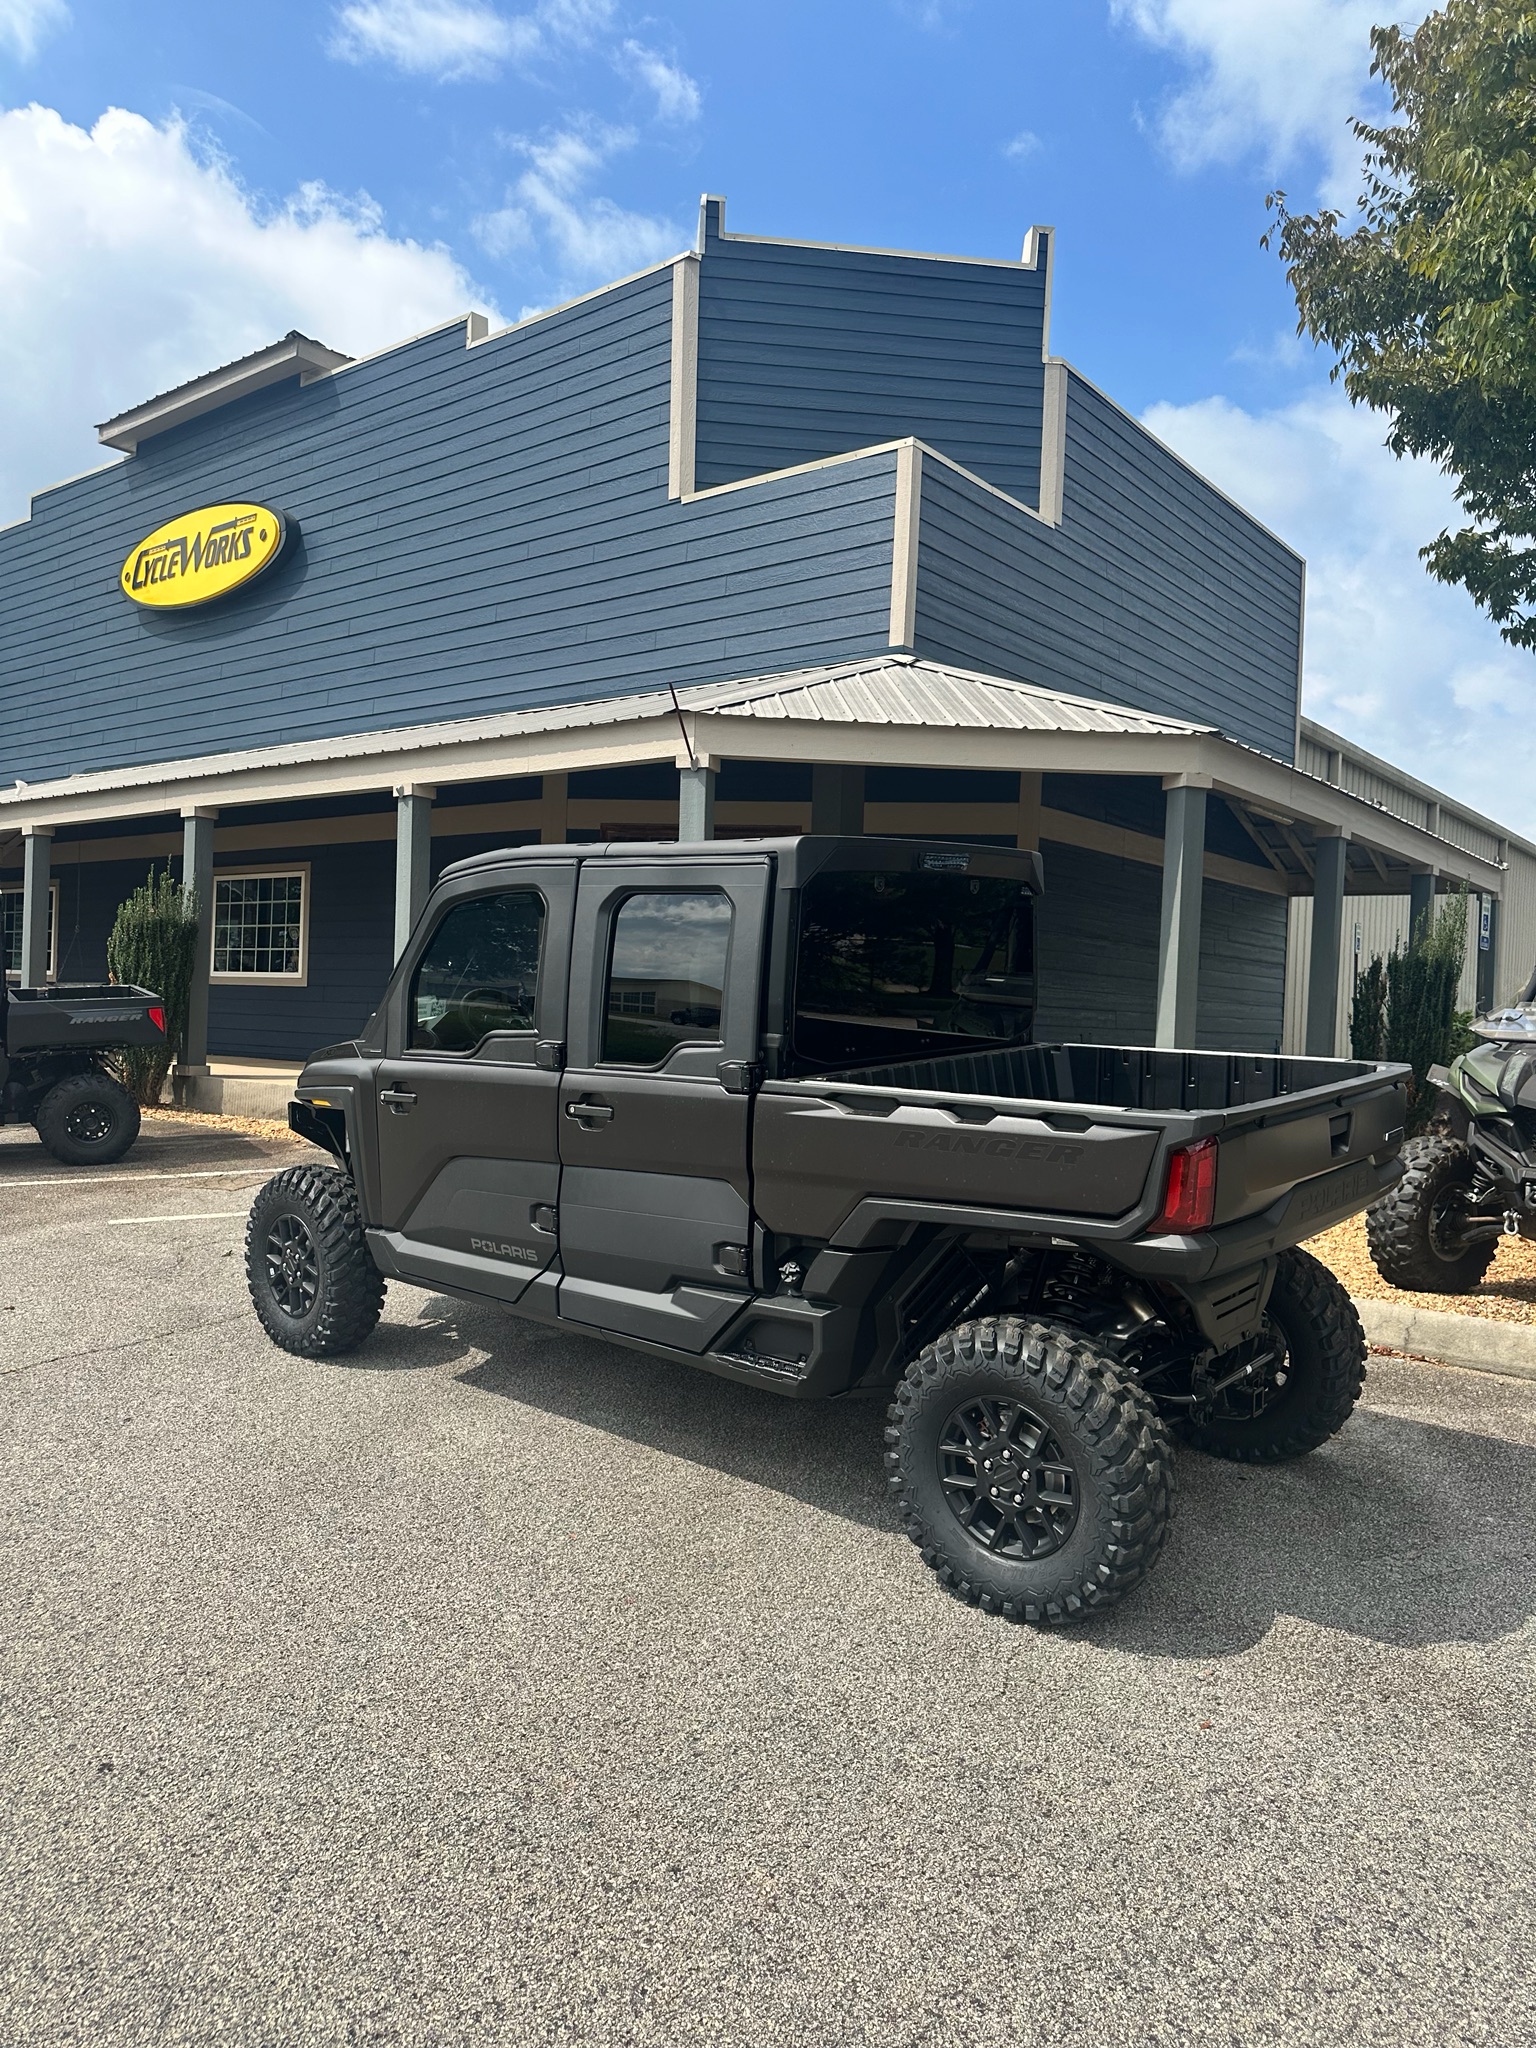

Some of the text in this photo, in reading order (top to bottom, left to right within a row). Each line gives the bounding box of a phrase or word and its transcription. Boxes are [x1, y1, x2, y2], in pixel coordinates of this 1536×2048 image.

[69, 1013, 143, 1025] RANGER
[893, 1129, 1085, 1165] RANGER
[470, 1237, 538, 1262] POLARIS
